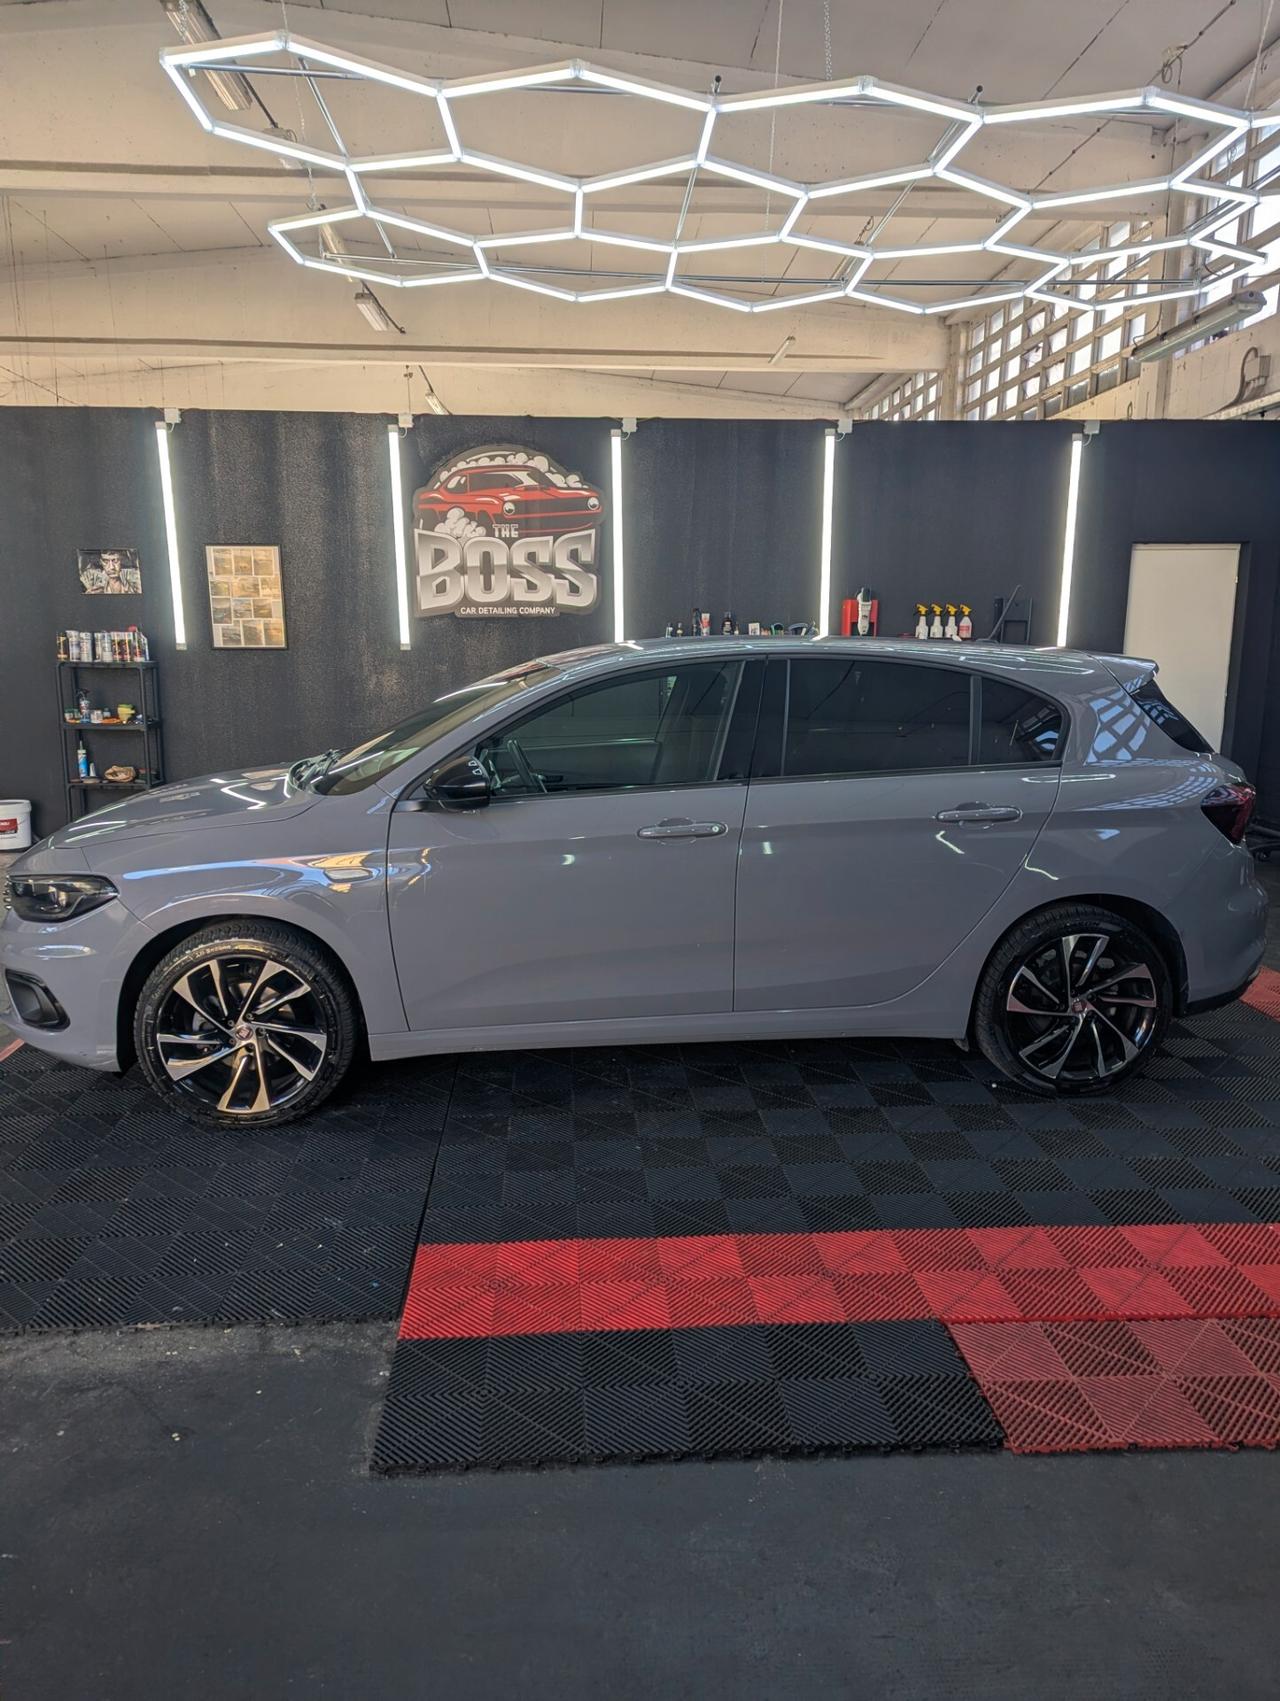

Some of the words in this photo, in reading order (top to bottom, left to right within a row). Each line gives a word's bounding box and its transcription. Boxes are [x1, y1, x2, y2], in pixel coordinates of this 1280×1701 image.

[492, 523, 519, 538] THE
[414, 529, 596, 609] BOSS
[460, 606, 476, 615] CAR
[478, 606, 516, 615] DETAILING
[519, 606, 556, 615] COMPANY
